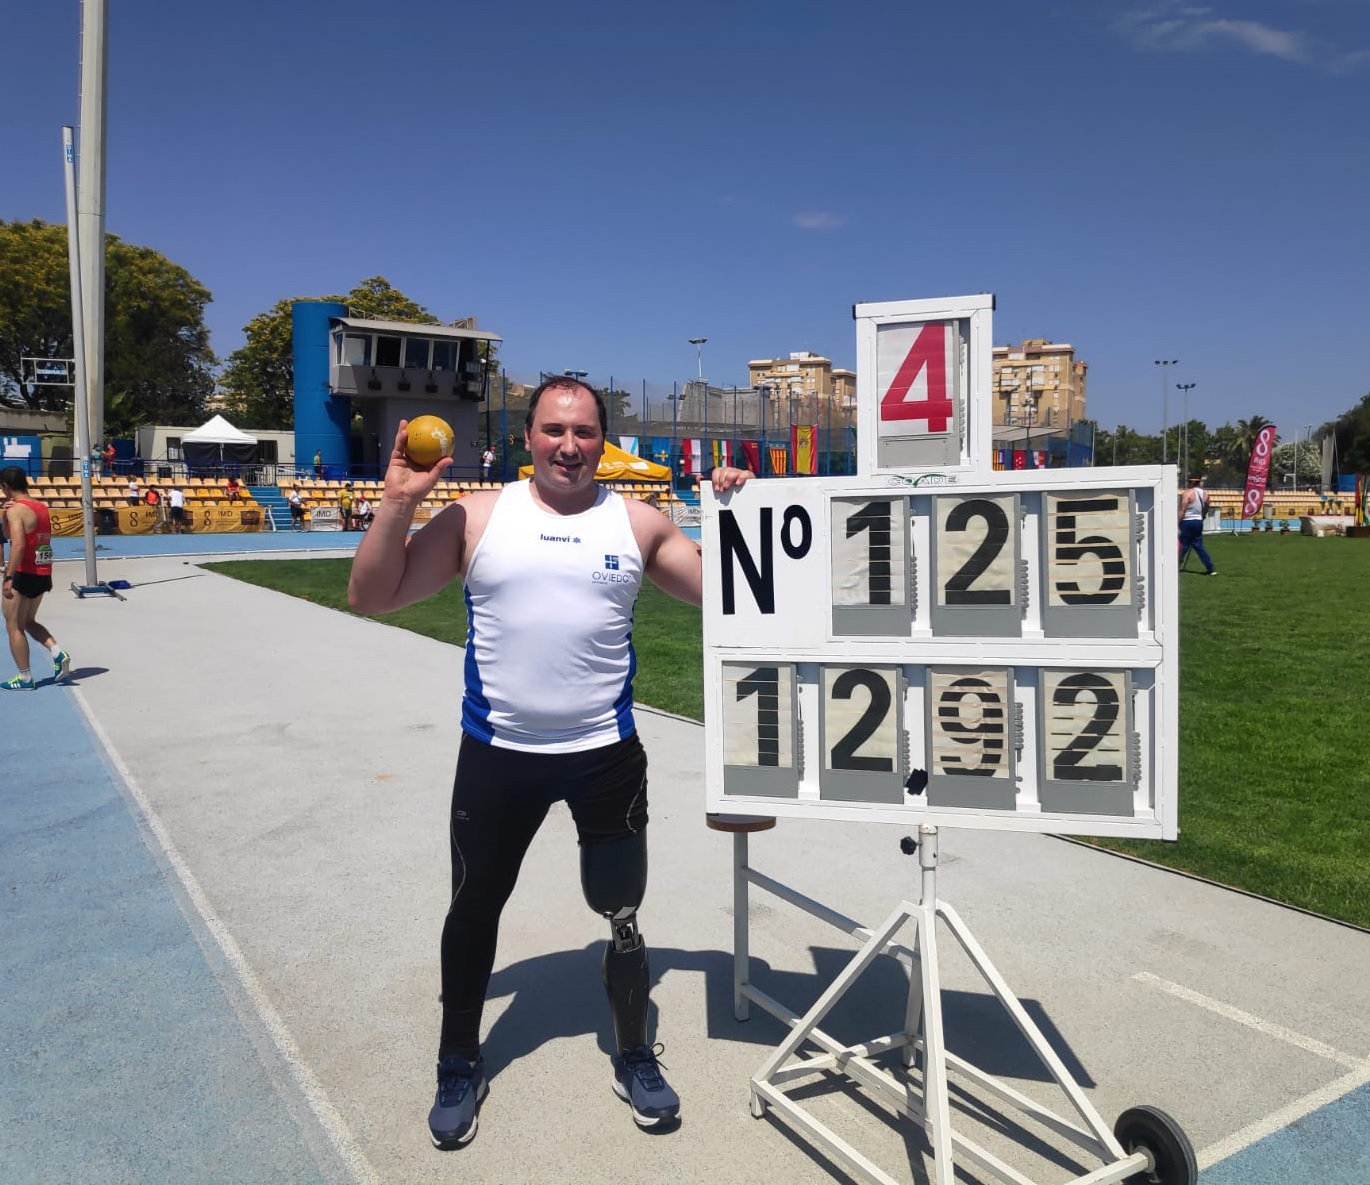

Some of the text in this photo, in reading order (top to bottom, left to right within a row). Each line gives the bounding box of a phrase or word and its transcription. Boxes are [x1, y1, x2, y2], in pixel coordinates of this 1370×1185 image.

[880, 321, 954, 433] 4
[539, 533, 571, 543] luanvi
[592, 571, 630, 584] OVIEDO
